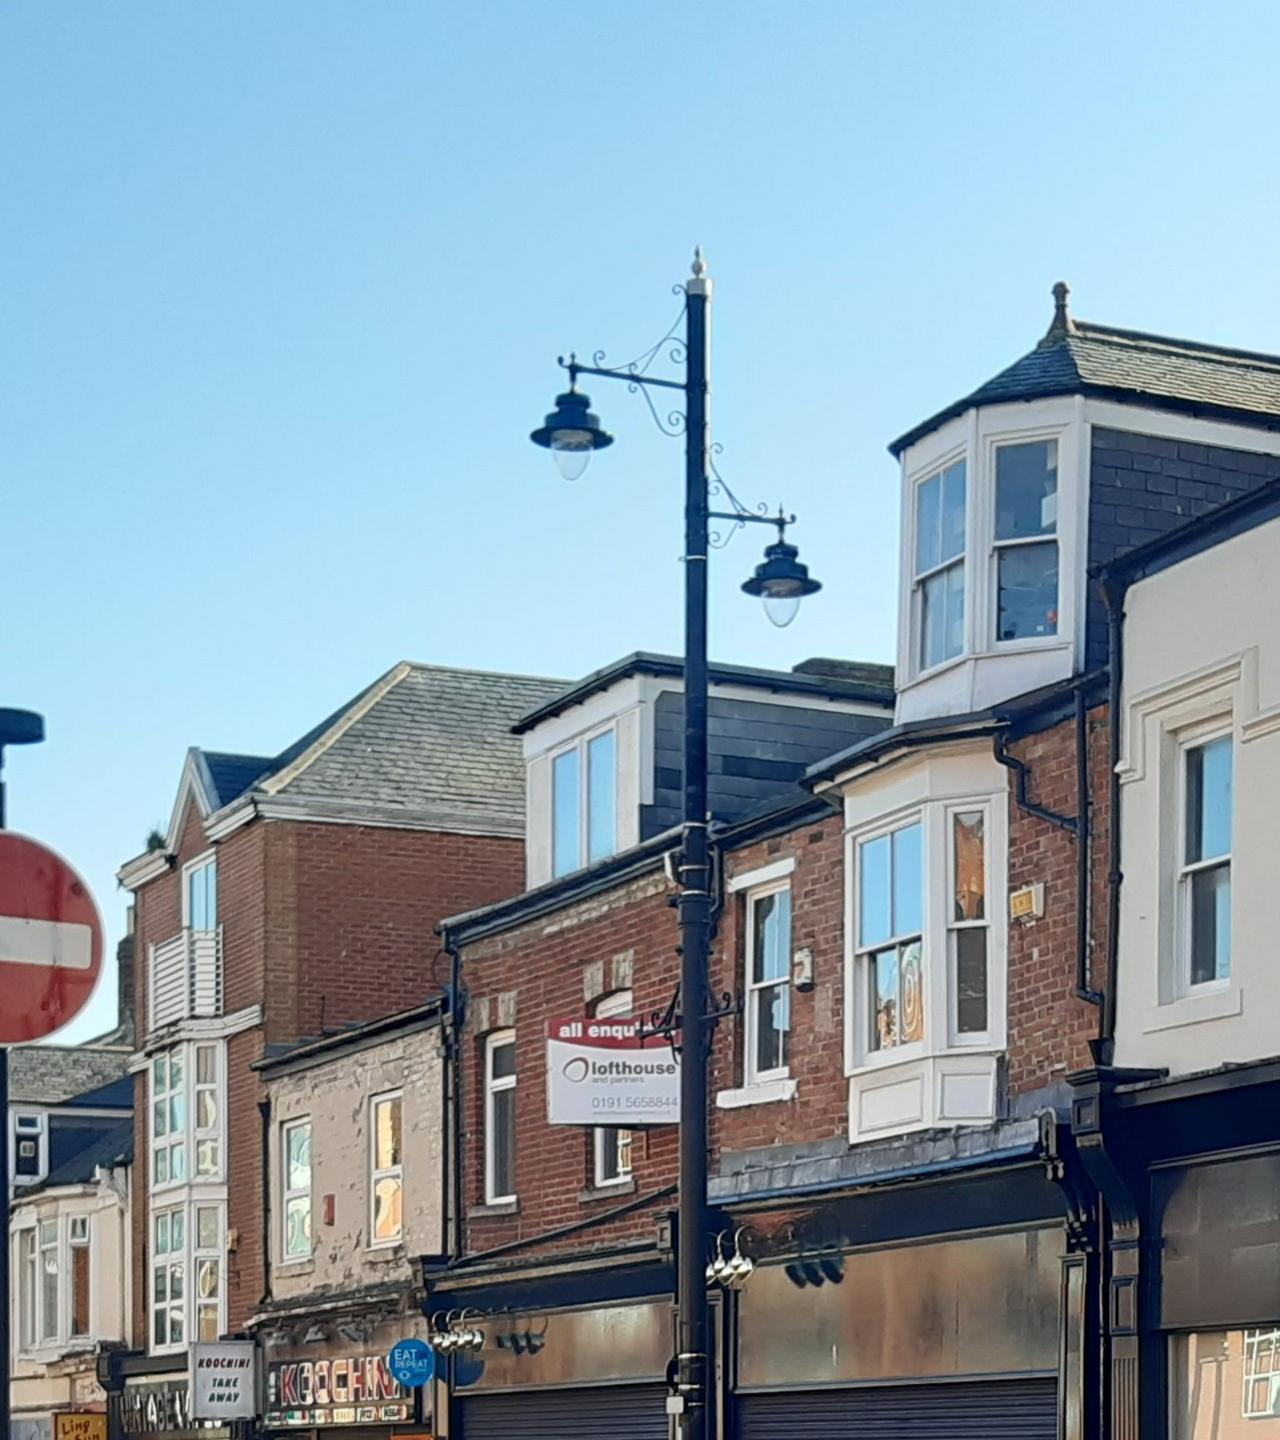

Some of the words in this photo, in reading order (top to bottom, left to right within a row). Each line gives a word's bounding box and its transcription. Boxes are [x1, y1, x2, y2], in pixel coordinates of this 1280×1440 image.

[559, 1021, 583, 1038] all
[591, 1061, 677, 1076] lofthouse
[591, 1096, 621, 1109] 0191
[394, 1348, 417, 1361] EAT
[197, 1358, 250, 1369] KOOCHINI
[393, 1359, 429, 1369] REPEAT
[212, 1377, 239, 1389] TAKE
[279, 1355, 407, 1408] KOOCHIN
[208, 1392, 240, 1403] AWAY
[61, 1419, 91, 1436] Ling
